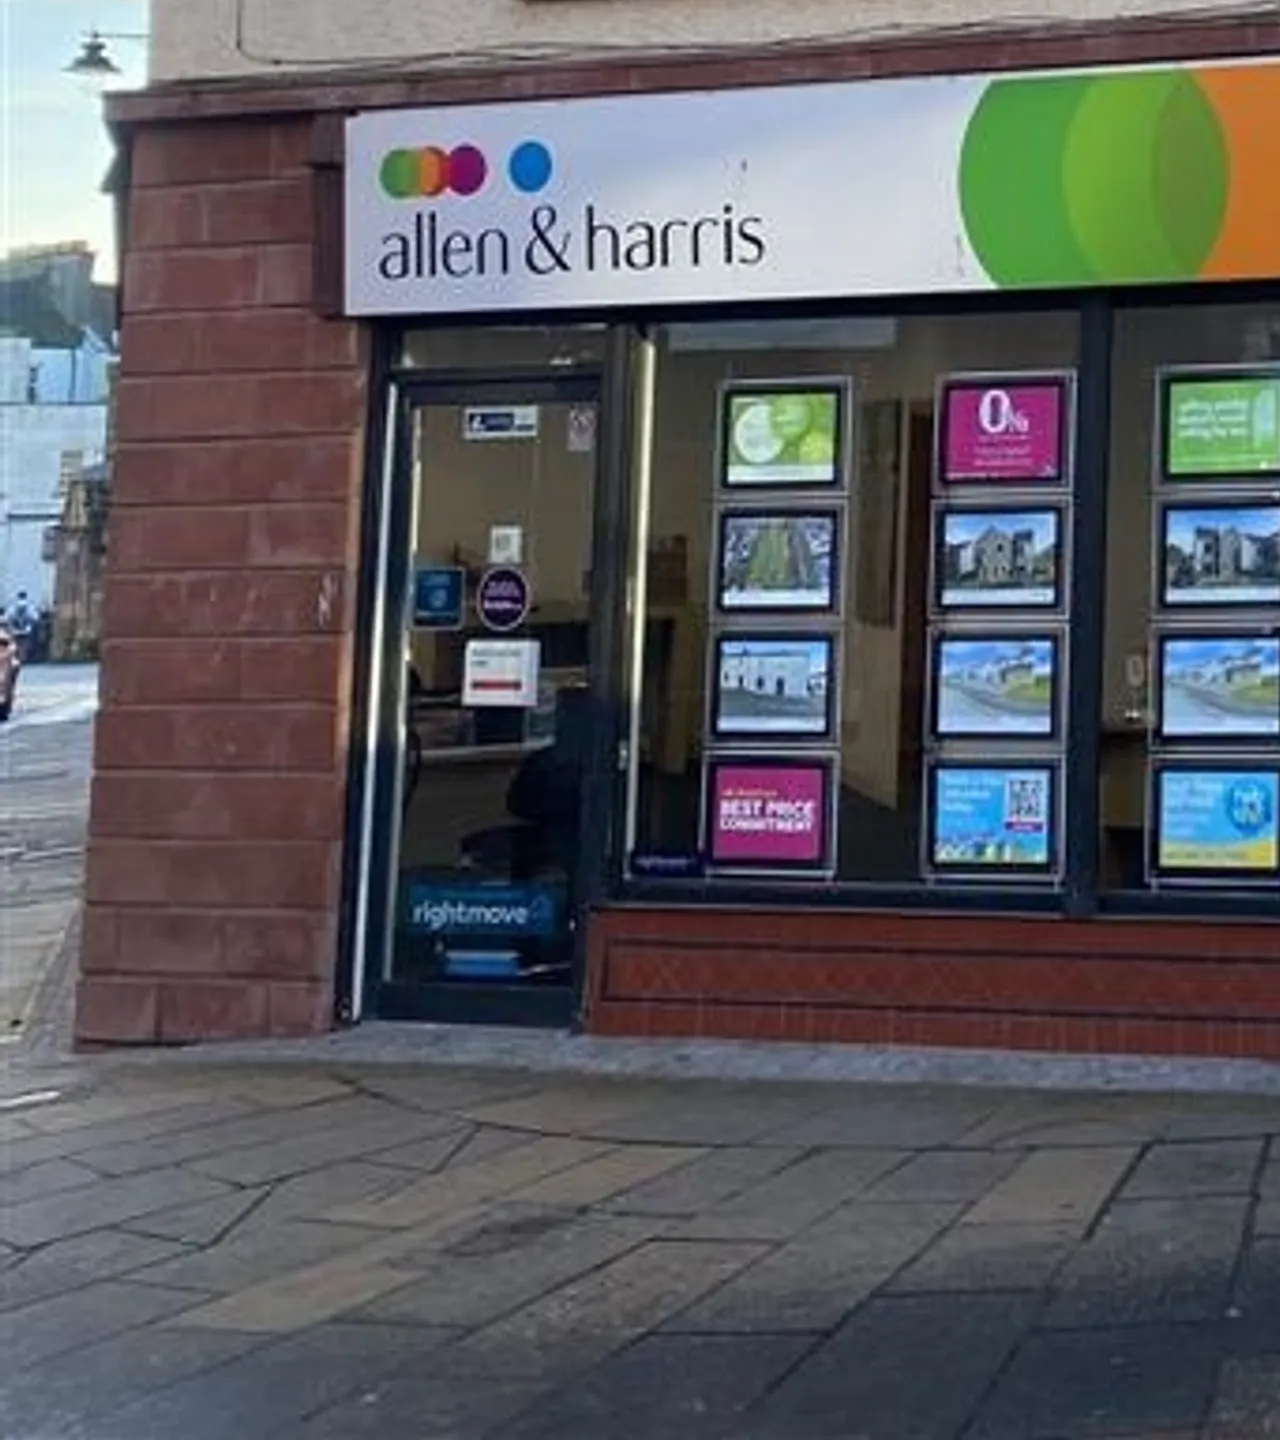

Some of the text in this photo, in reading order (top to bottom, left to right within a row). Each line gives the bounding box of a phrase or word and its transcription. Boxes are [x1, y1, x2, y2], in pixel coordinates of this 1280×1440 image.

[379, 204, 766, 280] allen & harris
[412, 902, 529, 930] rightmove
